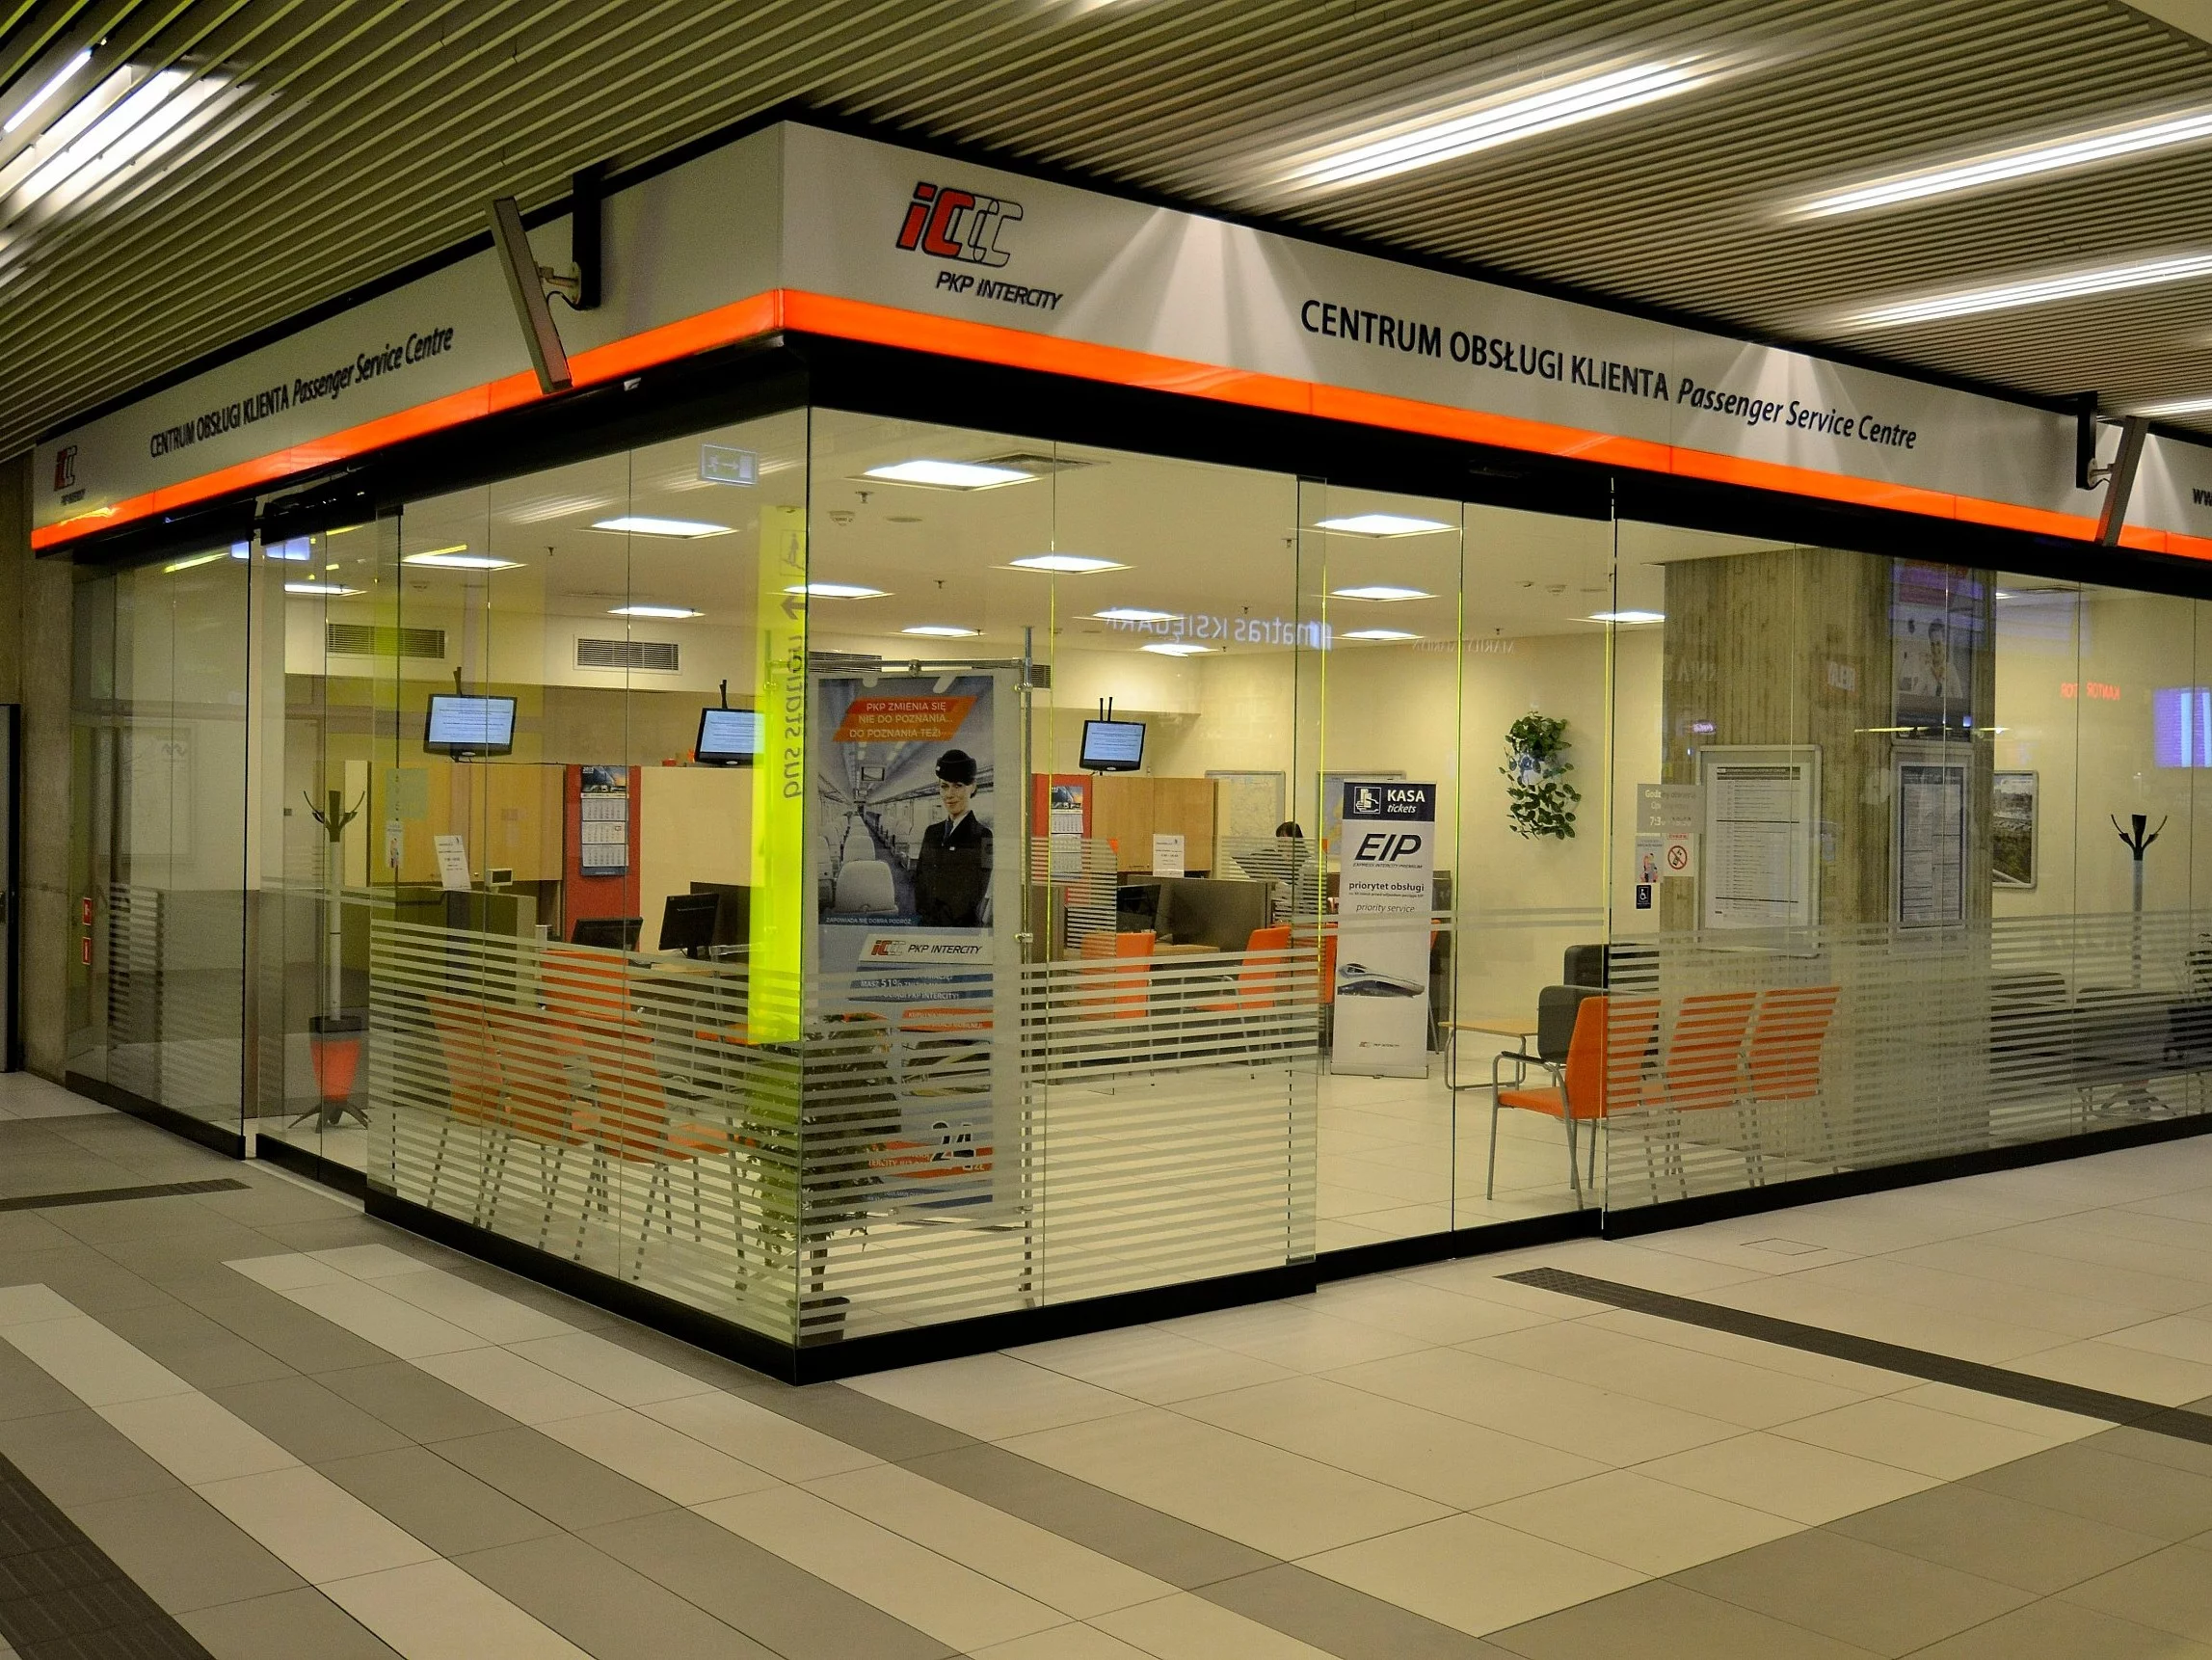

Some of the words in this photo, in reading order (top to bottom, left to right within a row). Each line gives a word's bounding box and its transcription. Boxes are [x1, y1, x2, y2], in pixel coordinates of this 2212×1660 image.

[936, 271, 974, 293] PKP
[975, 279, 1064, 310] INTERCITY
[1300, 299, 1442, 359] CENTRUM
[1449, 331, 1563, 382] OBSŁUGI
[1571, 355, 1669, 402] KLIENTA
[1676, 378, 1784, 426] Passenger
[1785, 400, 1854, 437] Service
[1858, 415, 1917, 449] Centre
[150, 419, 195, 458] CENTRUM
[196, 403, 241, 442] OBSŁUGI
[243, 385, 289, 425] KLIENTA
[292, 363, 355, 407] Passenger
[355, 343, 404, 385] Service
[405, 327, 454, 365] Centre
[866, 702, 886, 711] PKP
[889, 702, 929, 711] ZMIENIA
[931, 701, 946, 712] SIĘ
[858, 713, 875, 723] NIE
[878, 713, 893, 723] DO
[849, 729, 864, 738] DO
[868, 728, 918, 738] POZNANIA
[919, 726, 942, 737] TEŻ!
[1387, 789, 1426, 803] KASA
[1387, 803, 1417, 814] tickets
[1354, 833, 1422, 861] EIP
[1349, 881, 1388, 892] priorytet
[1391, 882, 1425, 894] obsługi
[1356, 903, 1385, 914] priority
[1388, 904, 1415, 913] service
[908, 944, 929, 953] PKP
[931, 945, 983, 954] INTERCITY
